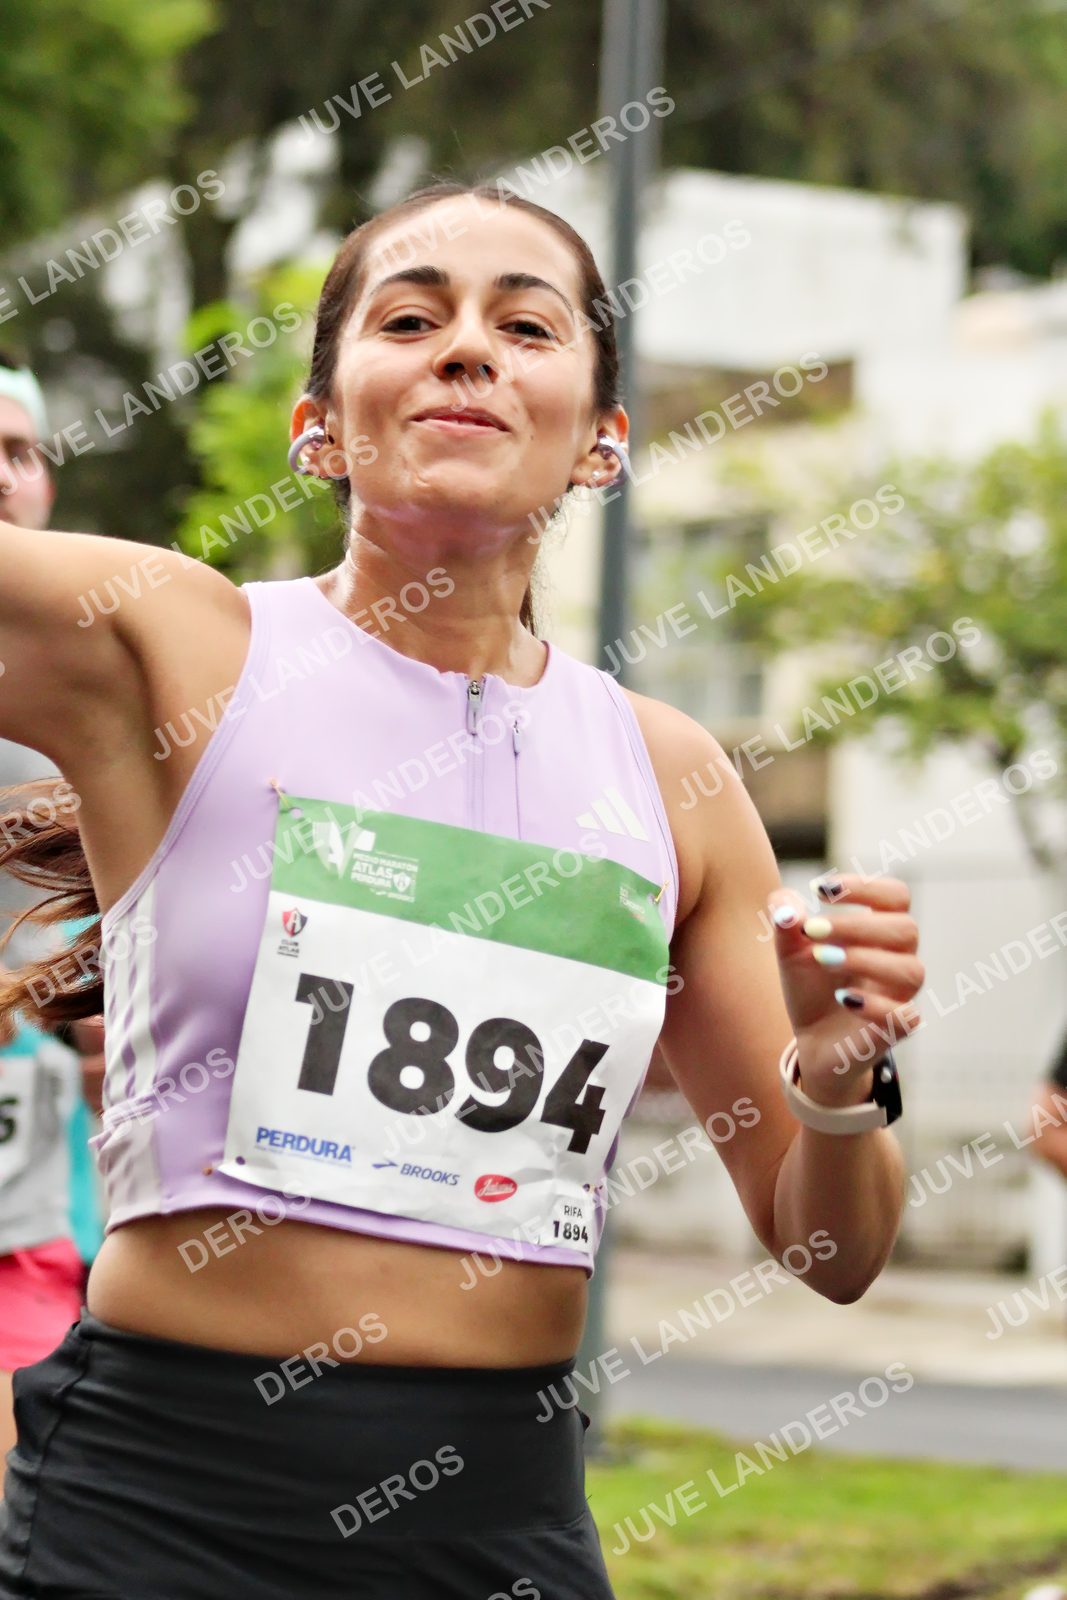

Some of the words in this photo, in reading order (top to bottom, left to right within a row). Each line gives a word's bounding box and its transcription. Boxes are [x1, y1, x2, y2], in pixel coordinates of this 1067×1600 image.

[352, 861, 394, 879] ATLAS
[295, 972, 610, 1154] 1894
[256, 1126, 352, 1162] PERDURA
[400, 1163, 460, 1187] BROOKS
[563, 1204, 583, 1219] RIFA
[553, 1220, 588, 1244] 1894
